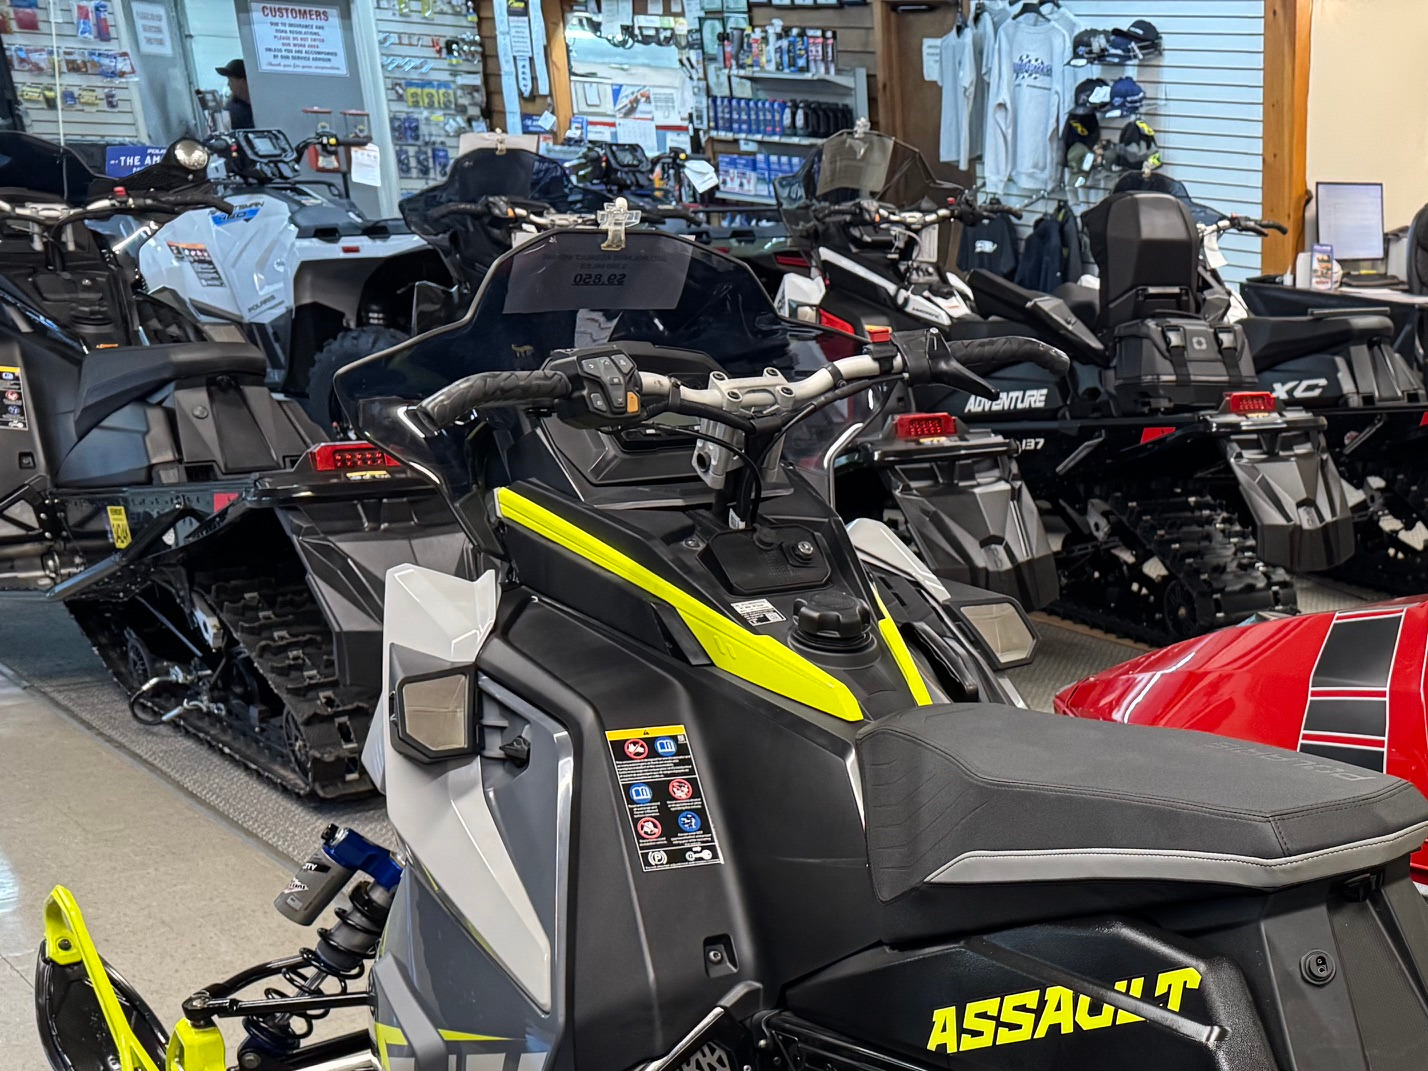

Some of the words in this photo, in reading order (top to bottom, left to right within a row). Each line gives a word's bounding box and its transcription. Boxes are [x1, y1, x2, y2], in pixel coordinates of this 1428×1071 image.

[262, 6, 329, 21] CUSTOMERS
[119, 155, 141, 166] THE
[1272, 378, 1328, 399] XC
[964, 388, 1048, 413] ADVENTURE
[1021, 438, 1045, 450] 137
[926, 966, 1202, 1053] ASSAULT
